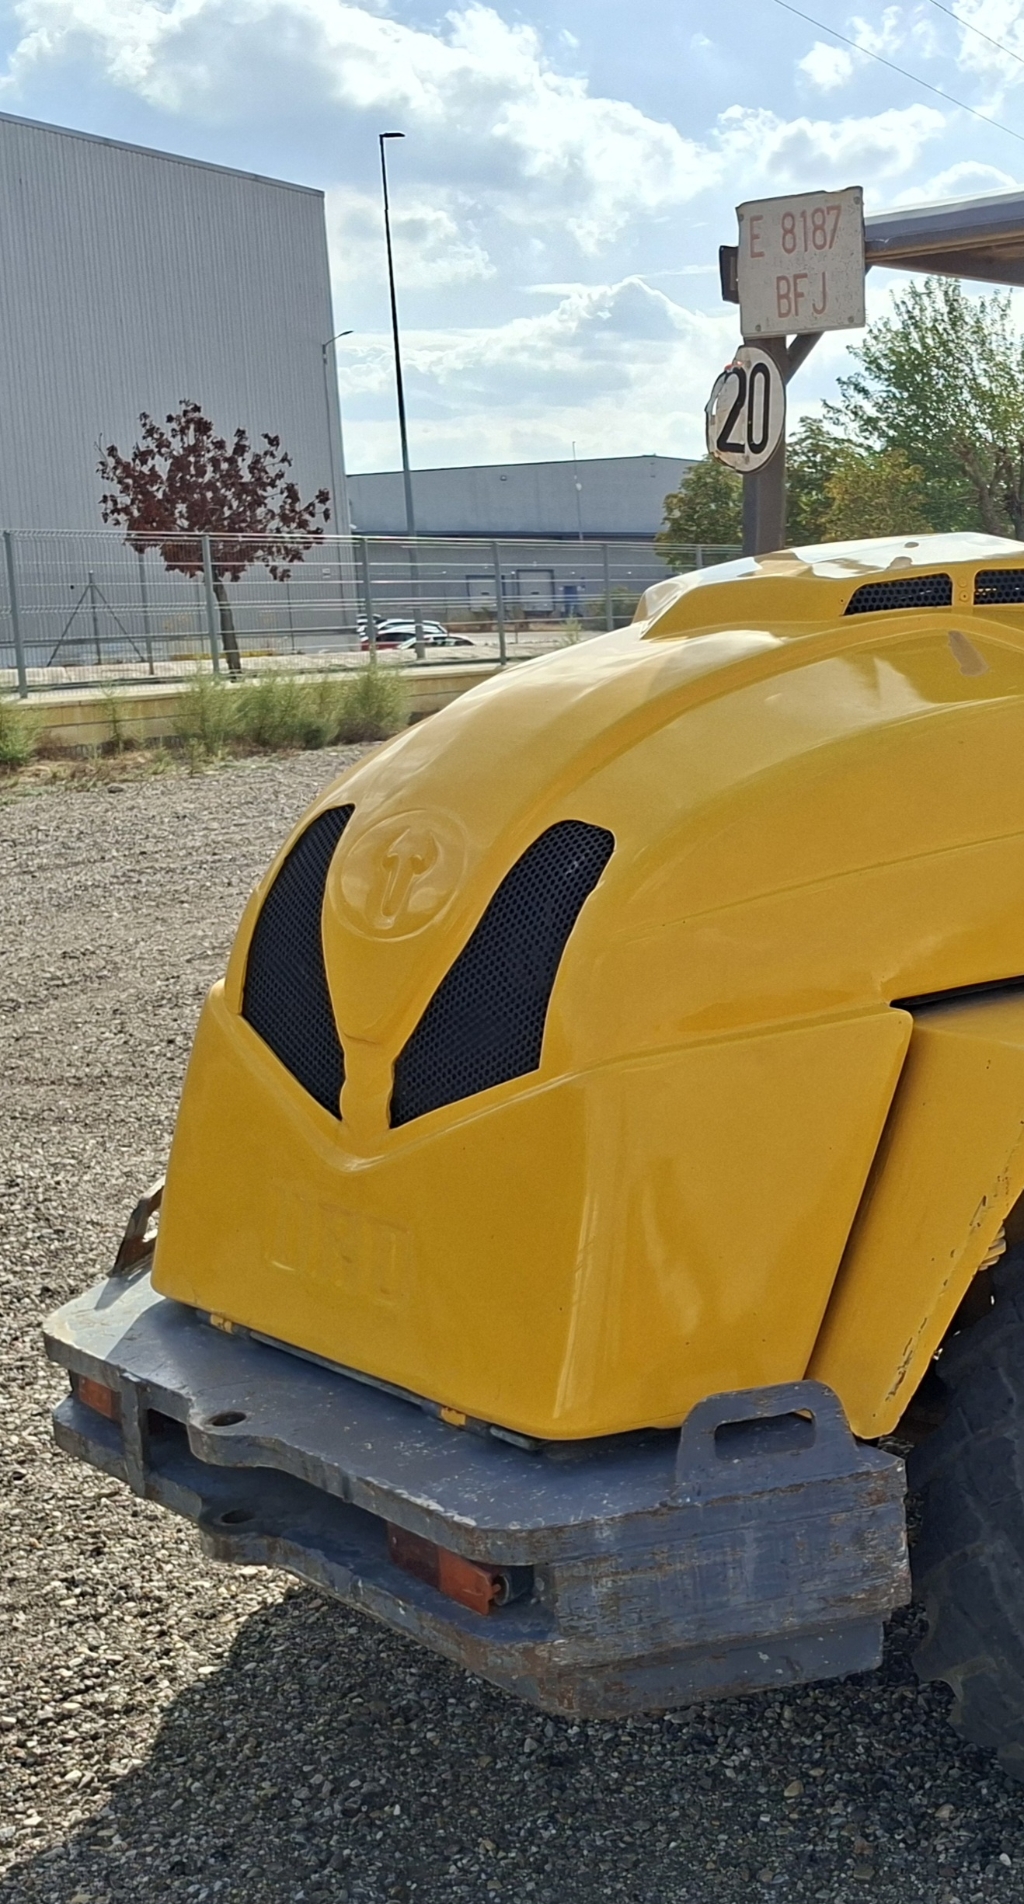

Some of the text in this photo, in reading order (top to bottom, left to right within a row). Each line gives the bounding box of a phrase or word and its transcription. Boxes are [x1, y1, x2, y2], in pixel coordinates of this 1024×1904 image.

[749, 205, 842, 259] E 8187
[776, 271, 828, 319] BFJ
[716, 362, 770, 454] 20
